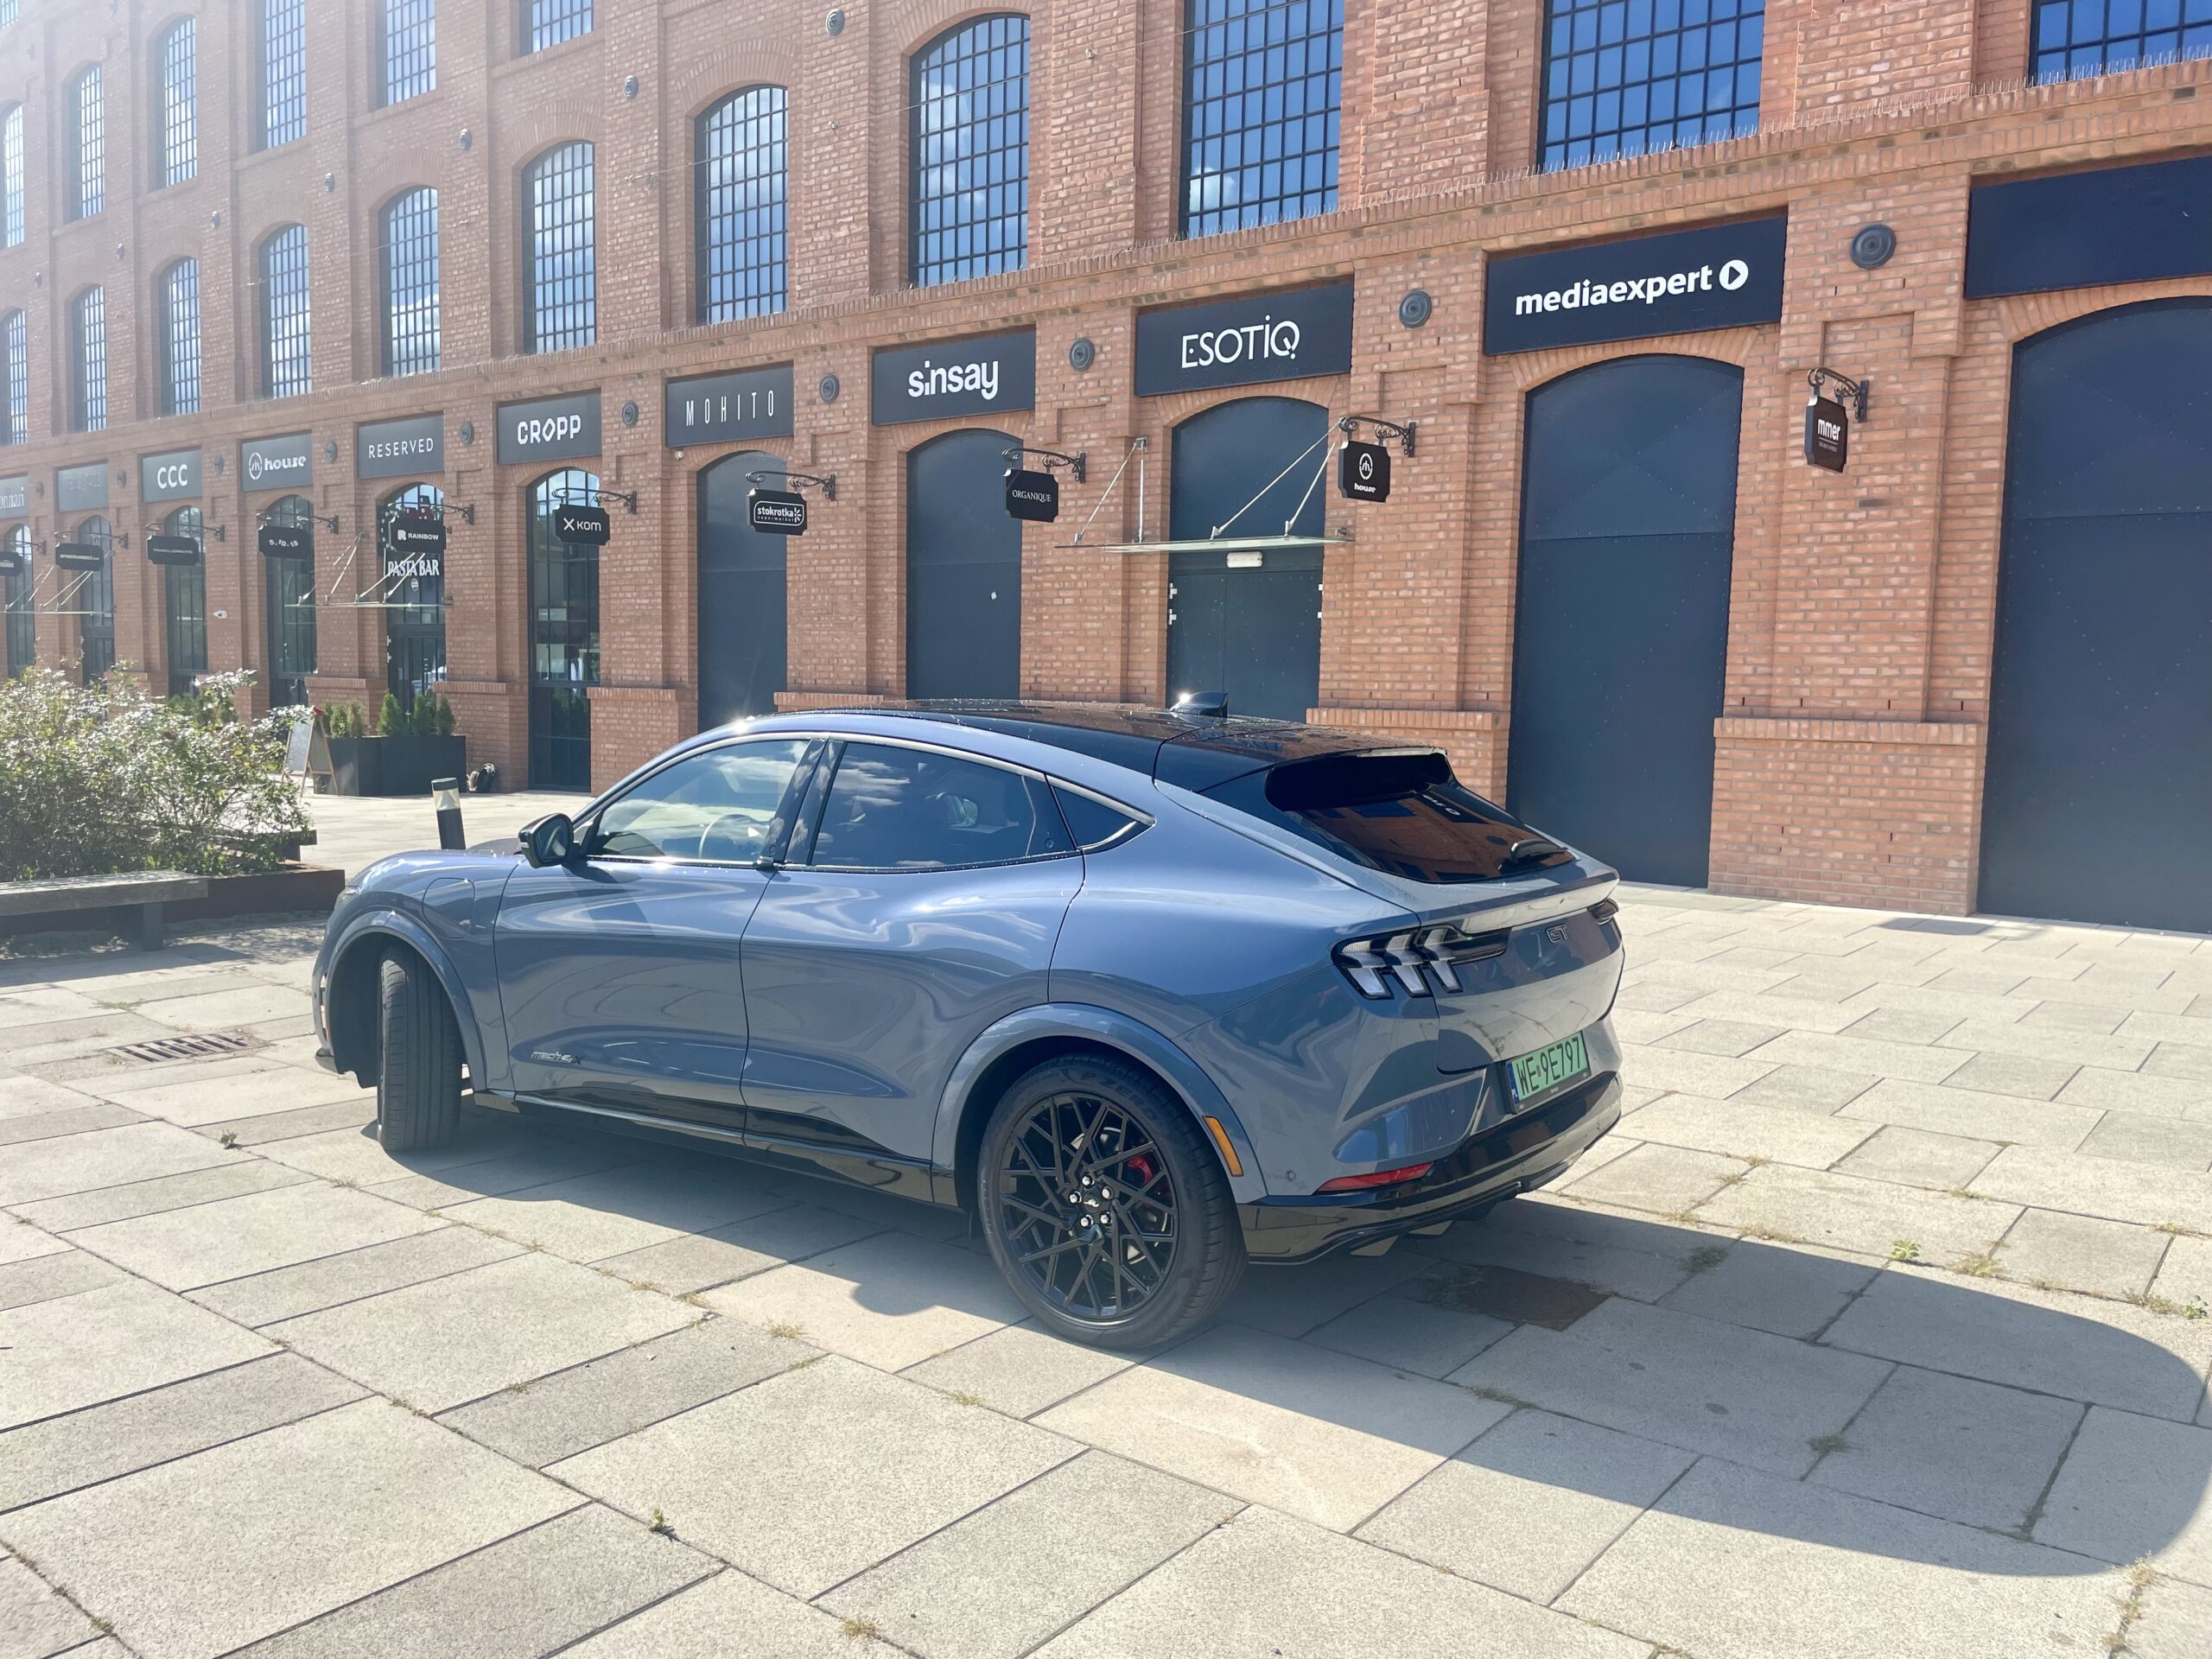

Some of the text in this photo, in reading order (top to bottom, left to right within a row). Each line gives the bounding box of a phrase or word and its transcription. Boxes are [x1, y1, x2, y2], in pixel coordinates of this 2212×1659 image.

[1515, 264, 1713, 316] mediaexpert
[907, 359, 999, 400] sinsay
[685, 389, 775, 427] MOHITO
[517, 414, 582, 445] CROPP
[368, 436, 434, 460] RESERVED
[264, 455, 307, 471] house
[156, 463, 188, 490] CCC
[1012, 489, 1052, 503] ORGANIQUE
[1354, 482, 1376, 493] house
[757, 505, 794, 518] stokrotka
[408, 532, 439, 541] RAINBOW
[387, 559, 440, 577] PASTA BAR
